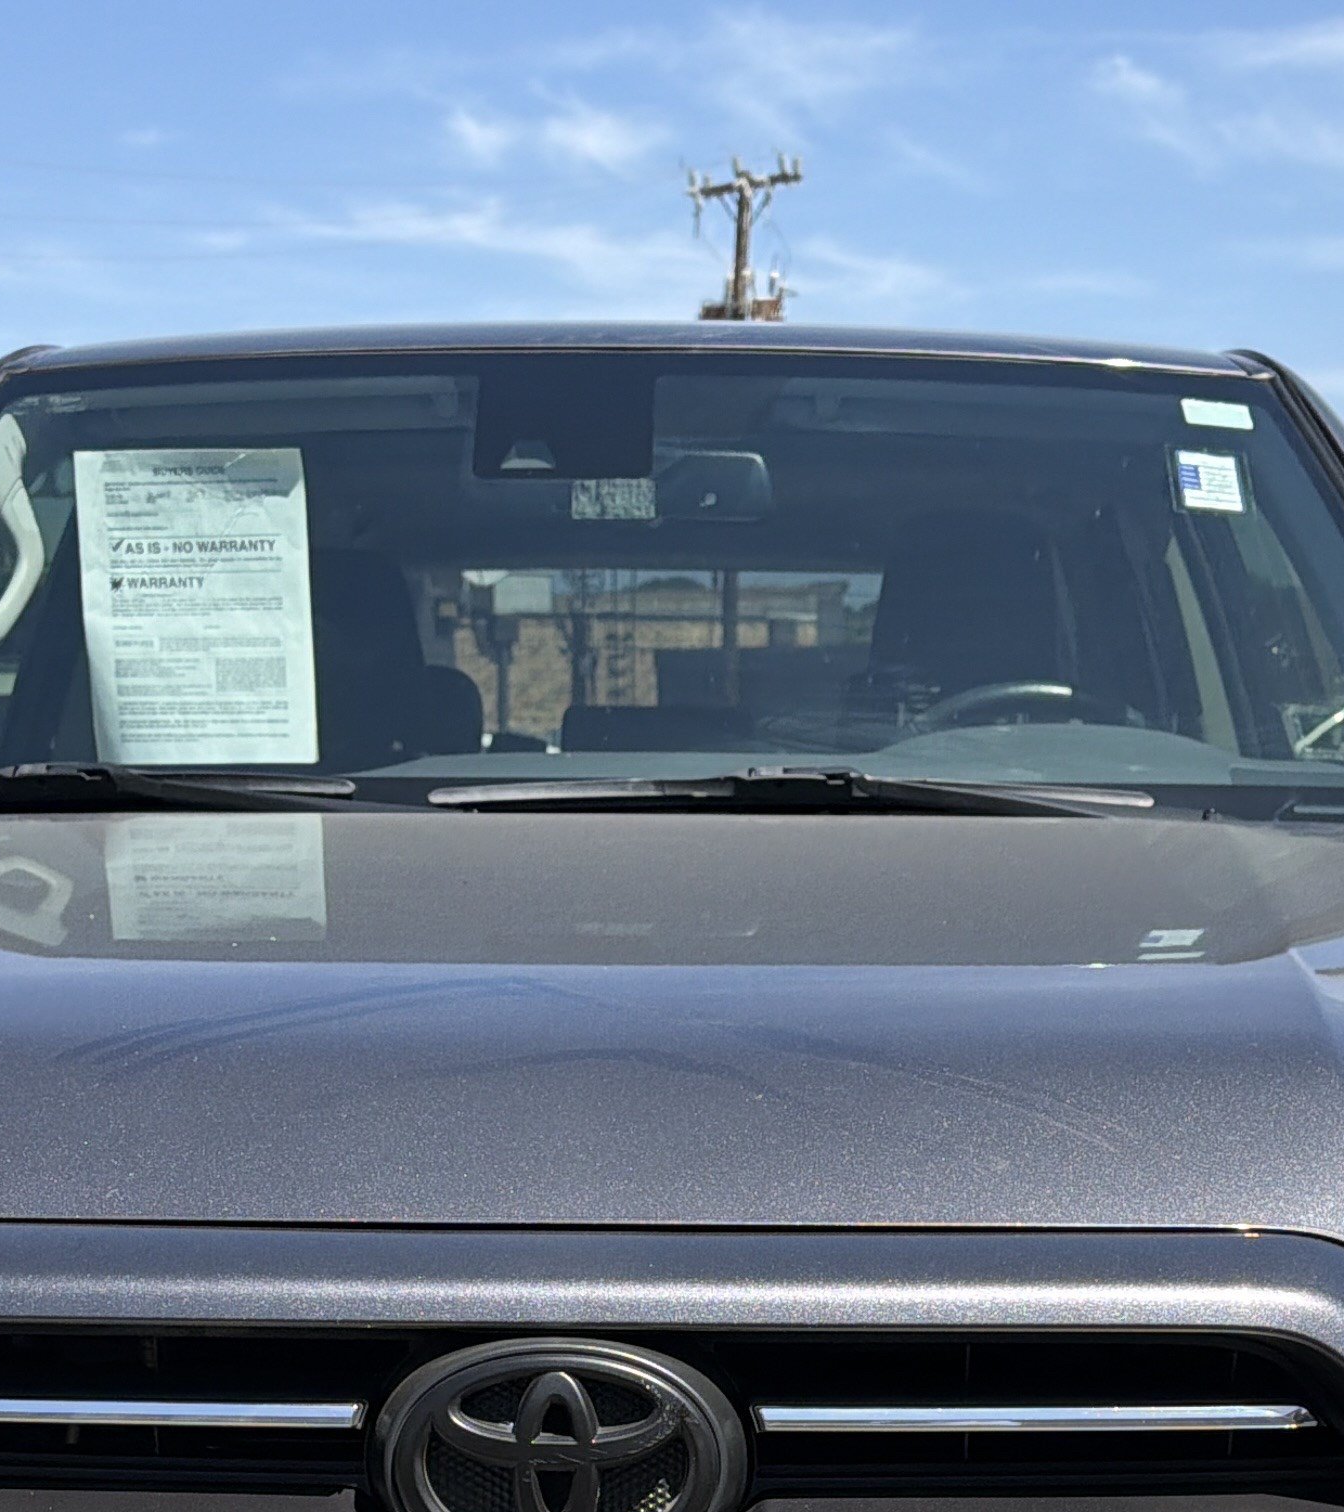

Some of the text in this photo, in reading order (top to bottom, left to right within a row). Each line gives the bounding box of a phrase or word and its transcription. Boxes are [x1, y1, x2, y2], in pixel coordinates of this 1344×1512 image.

[125, 542, 144, 554] AS
[147, 541, 161, 554] IS
[172, 541, 194, 553] NO
[196, 539, 276, 553] WARRANTY
[126, 576, 205, 590] WARRANTY
